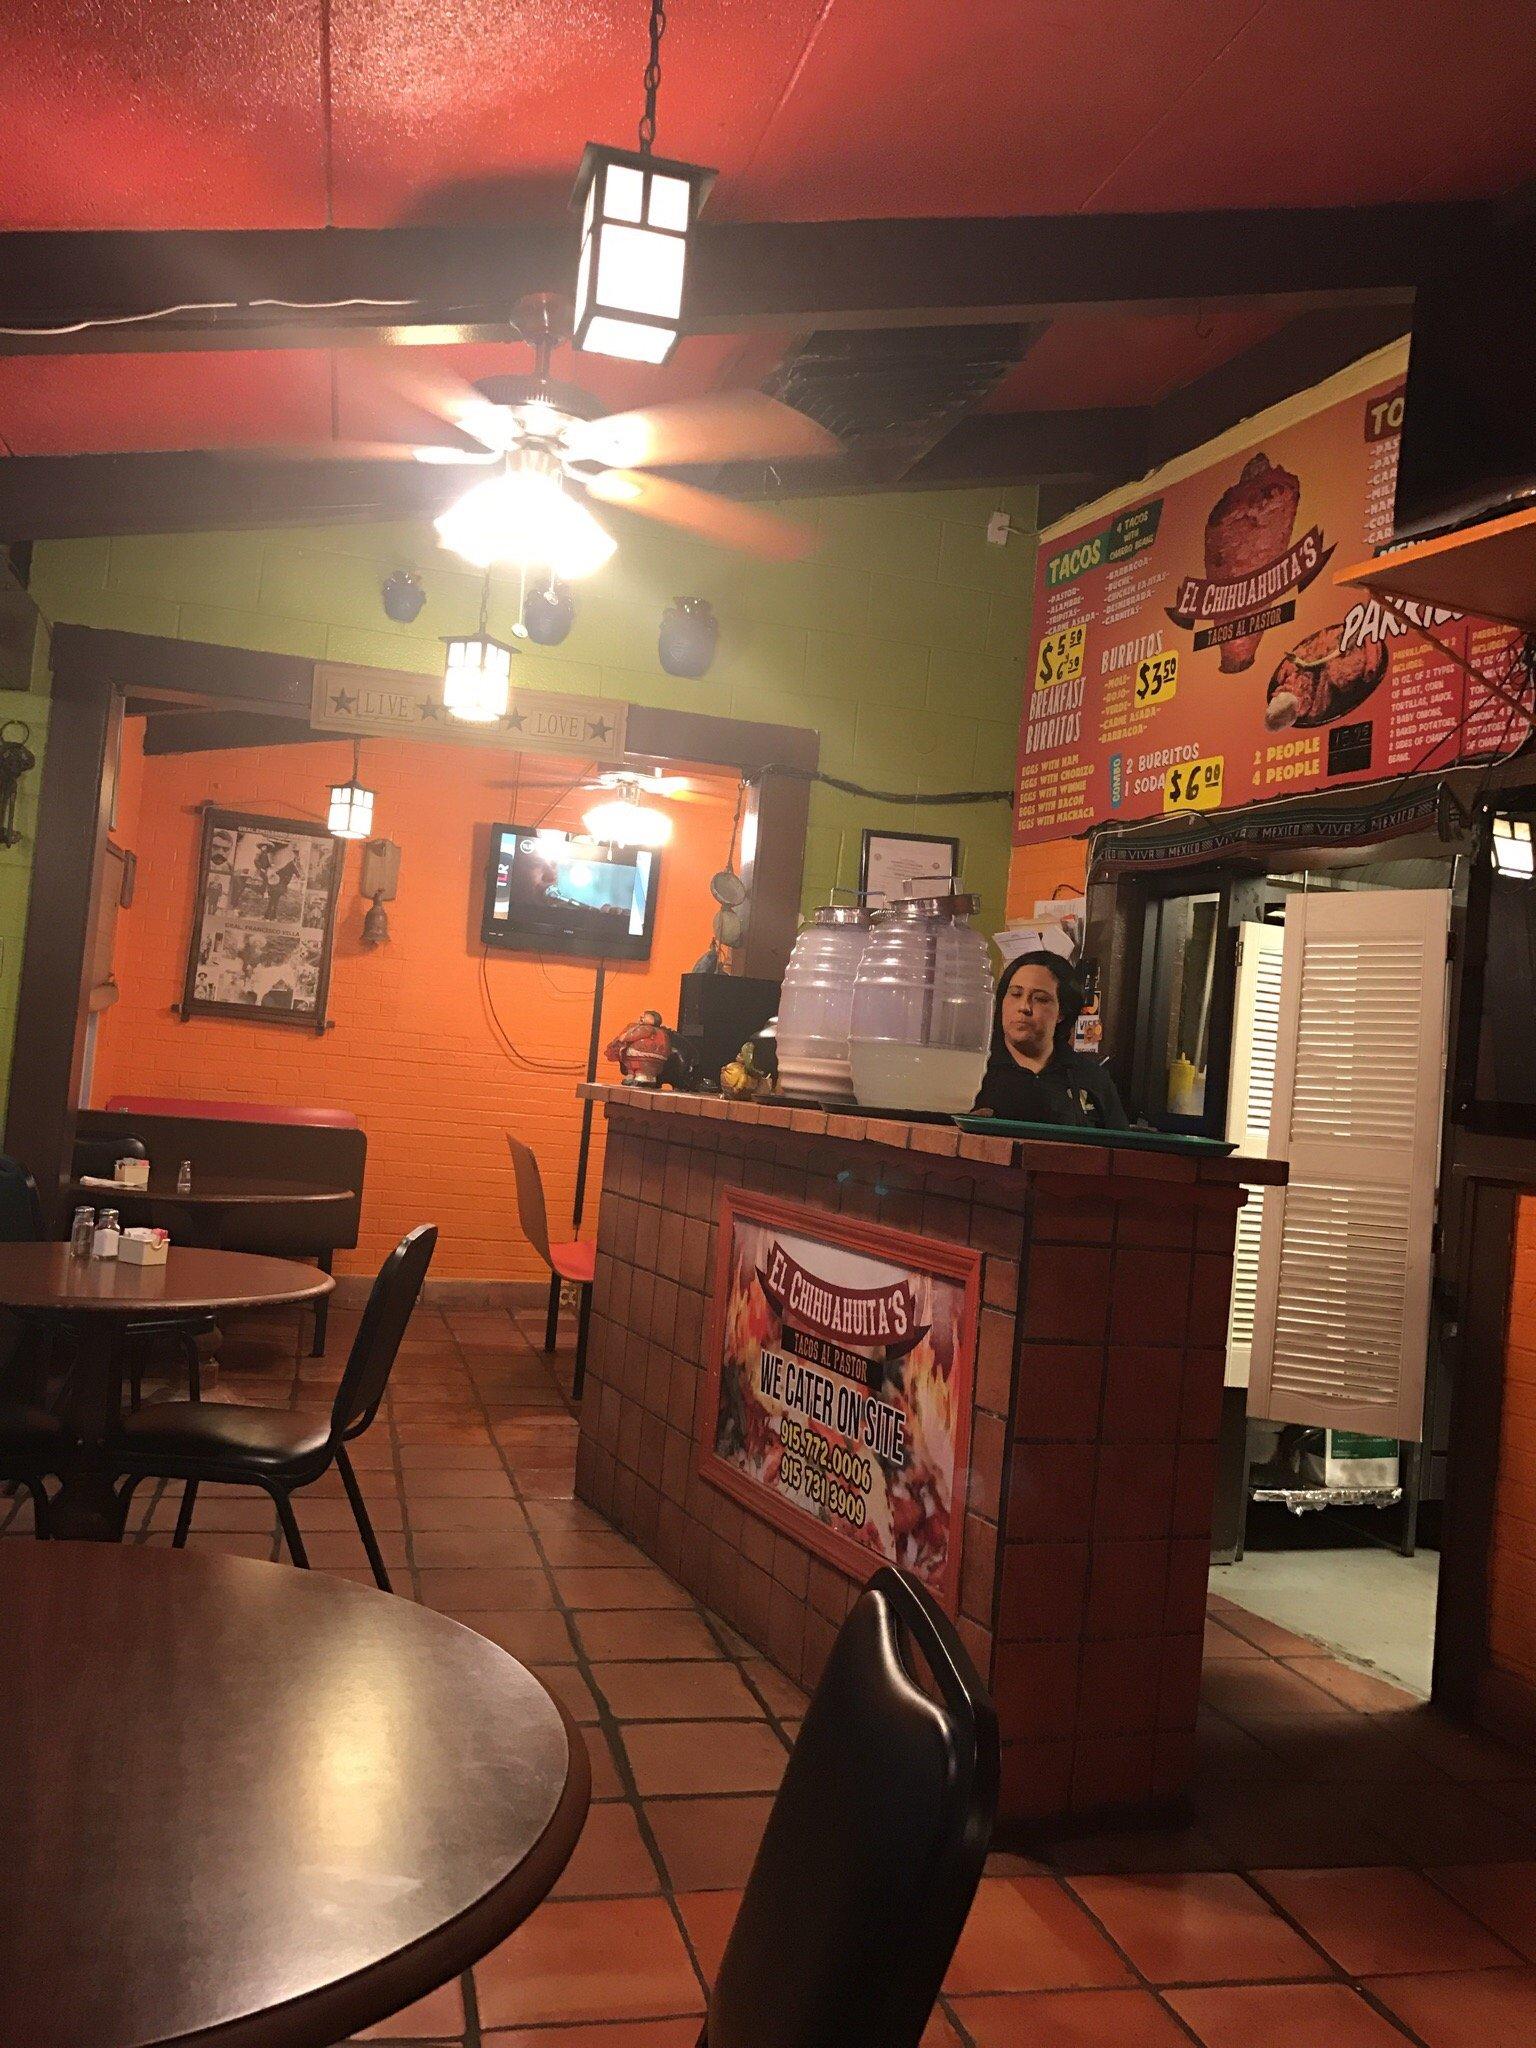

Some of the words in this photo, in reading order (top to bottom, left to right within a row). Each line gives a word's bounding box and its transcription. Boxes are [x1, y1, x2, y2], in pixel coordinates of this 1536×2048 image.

[1049, 539, 1101, 583] TACOS
[1178, 582, 1200, 613] EL
[1201, 536, 1317, 616] CHIHUAHUITA'S
[1207, 623, 1234, 645] TACOS
[1235, 618, 1247, 637] AL
[1250, 608, 1282, 633] PASTOR
[1100, 630, 1163, 674] BURRITOS
[365, 693, 409, 717] LIVE
[536, 712, 579, 738] LOVE
[1029, 676, 1086, 721] BREAKFAST
[1026, 711, 1081, 754] BURRITOS
[1253, 751, 1262, 765] 2
[1266, 736, 1320, 762] PEOPLE
[1112, 758, 1121, 802] COMBO
[1126, 758, 1133, 774] 2
[1138, 742, 1200, 772] BURRITOS
[1252, 770, 1261, 785] 4
[1266, 758, 1320, 783] PEOPLE
[1134, 773, 1165, 796] SODA
[768, 1249, 788, 1295] EL
[789, 1270, 908, 1336] CHIHUAHUITA'S
[794, 1333, 819, 1361] TACOS
[821, 1344, 832, 1369] AL
[834, 1351, 868, 1383] PASTOR
[761, 1350, 783, 1400] WE
[785, 1363, 834, 1427] CATER
[837, 1386, 862, 1440] ON
[864, 1397, 906, 1465] SITE
[780, 1418, 872, 1494] 915.772.0006
[780, 1453, 803, 1490] 915
[804, 1465, 827, 1505] 731
[828, 1480, 866, 1529] 3909
